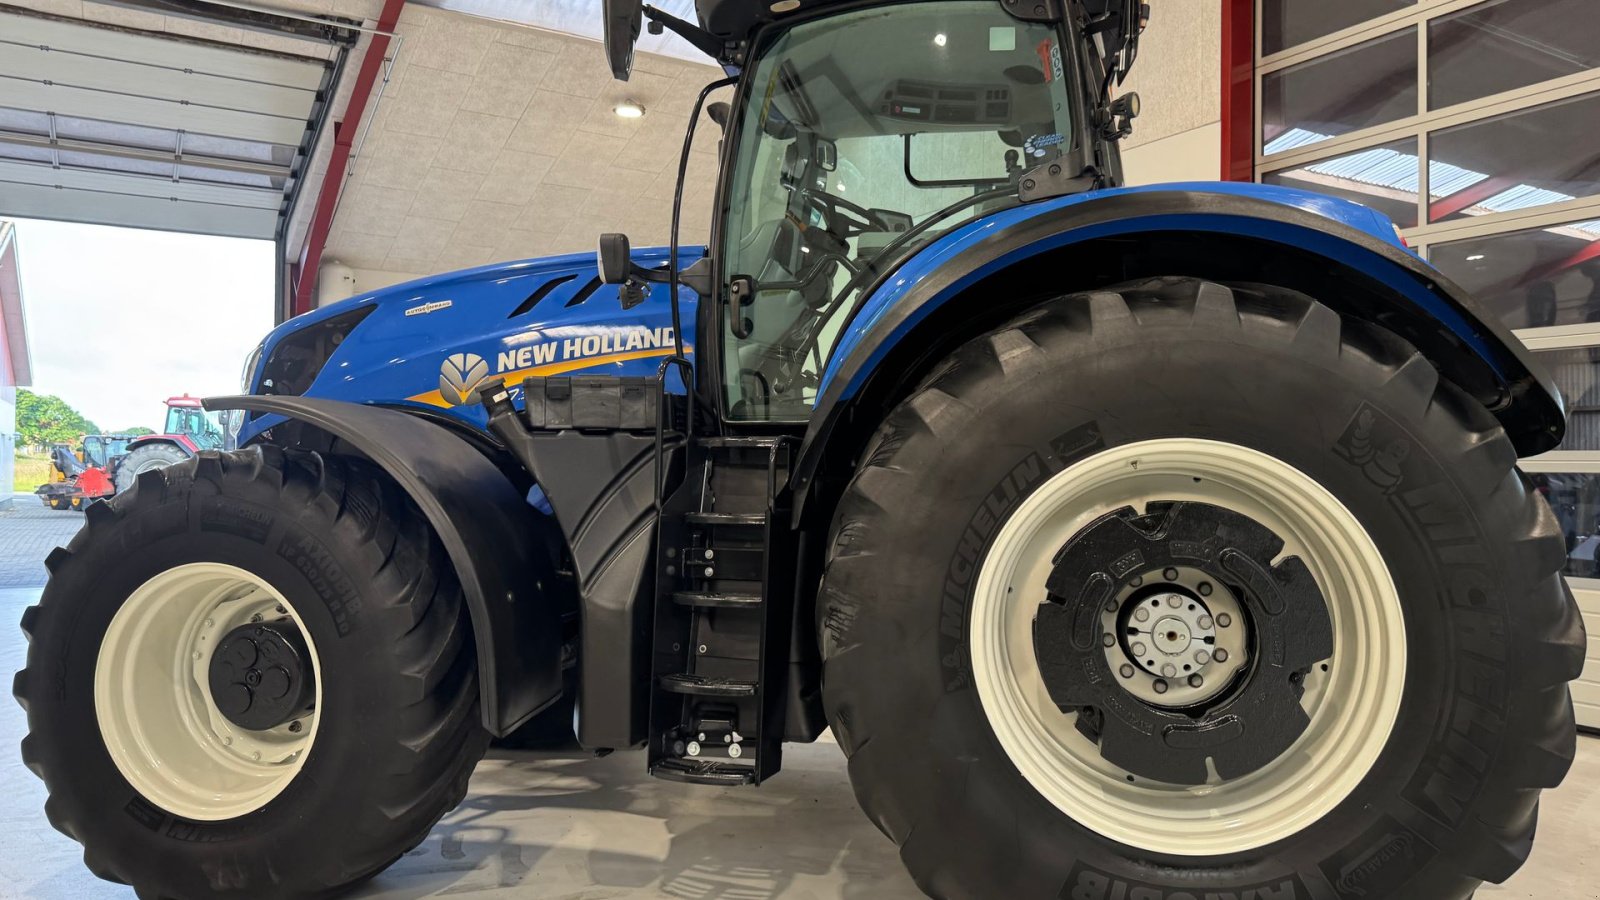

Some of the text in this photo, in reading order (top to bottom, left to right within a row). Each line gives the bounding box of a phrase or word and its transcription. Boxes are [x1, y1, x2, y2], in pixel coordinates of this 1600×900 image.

[497, 327, 676, 373] NEW HOLLAND
[940, 453, 1042, 638] MICHELIN
[1399, 482, 1508, 826] MICHELIN
